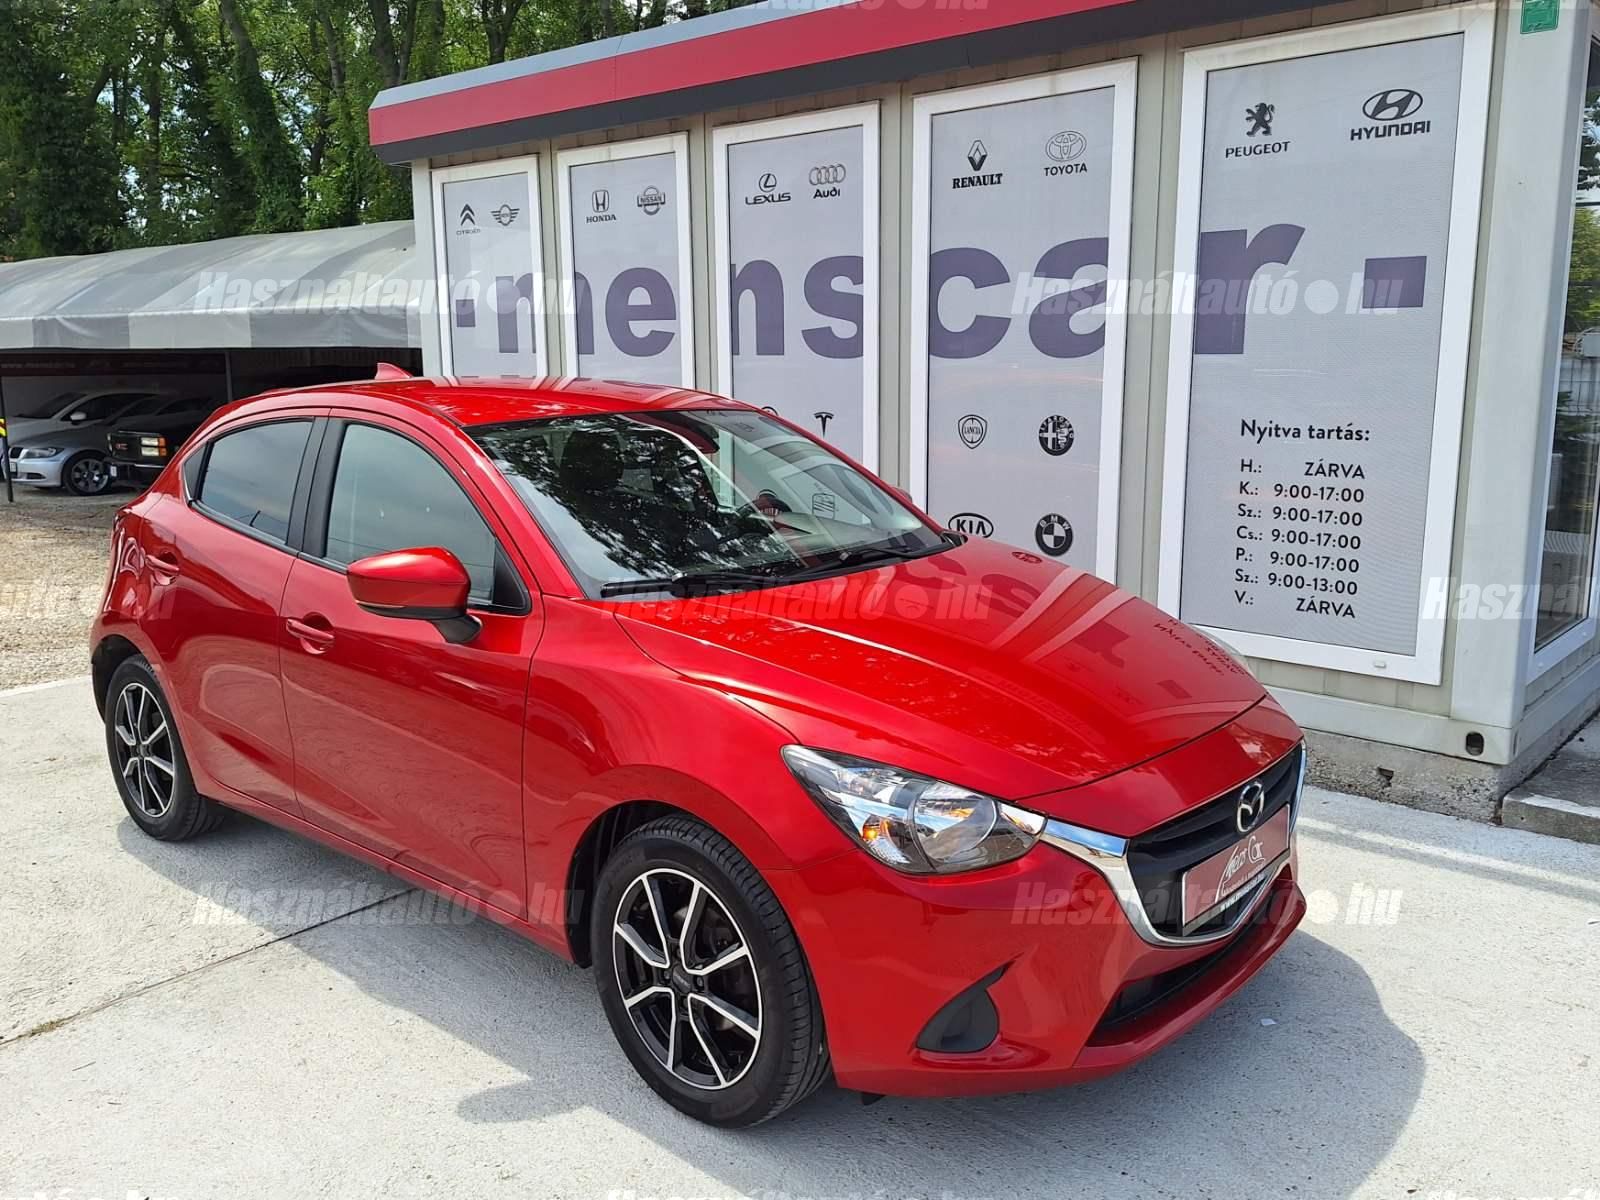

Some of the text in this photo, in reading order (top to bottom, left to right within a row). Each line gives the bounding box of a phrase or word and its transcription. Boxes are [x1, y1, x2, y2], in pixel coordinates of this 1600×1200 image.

[1350, 120, 1431, 141] HYUNDAI
[1225, 141, 1290, 159] PEUGEOT
[1044, 162, 1088, 177] TOYOTA
[952, 173, 1003, 189] RENAULT
[745, 192, 791, 205] LEXUS
[813, 187, 841, 199] Audi
[586, 214, 617, 224] HONDA
[1240, 418, 1370, 444] Nyitva tartás:
[1240, 458, 1365, 479] H.: ZÁRVA
[1239, 481, 1365, 503] K.: 9:00-17:00
[1237, 503, 1363, 526] Sz.: 9:00-17:00
[957, 519, 987, 535] KIA
[1236, 526, 1361, 549] Cs.: 9:00-17:00
[1236, 547, 1360, 573] P.: 9:00-17:00
[1235, 569, 1358, 595] Sz.: 9:00-13:00
[1235, 590, 1356, 618] V.: ZÁRVA
